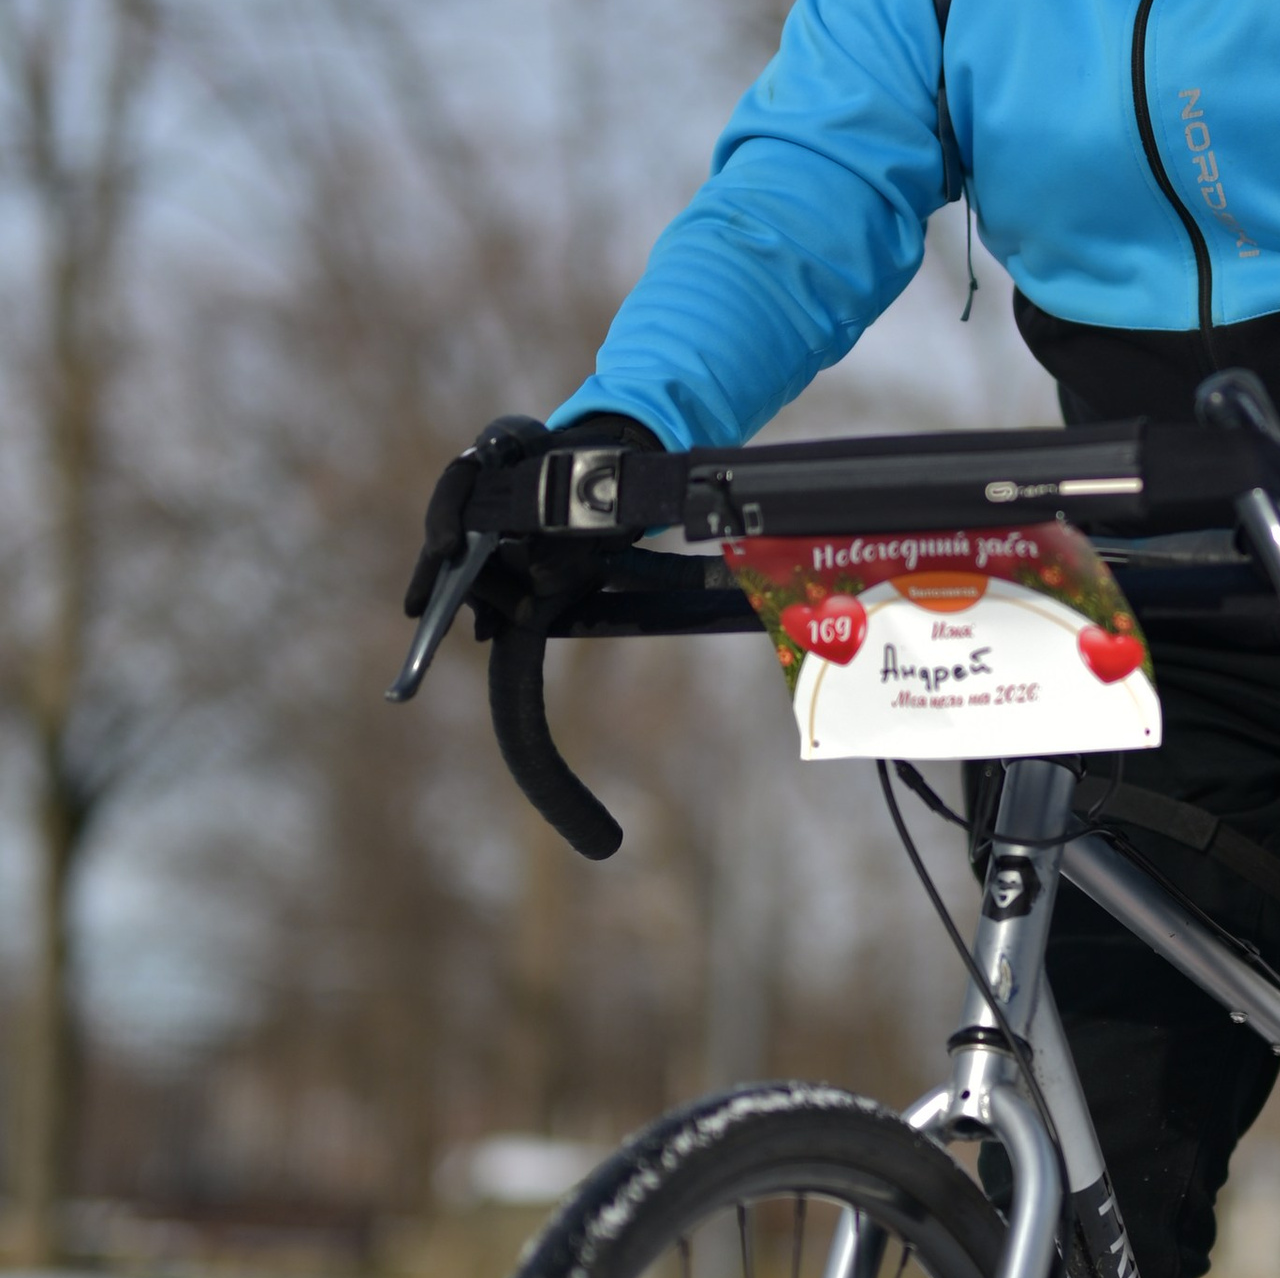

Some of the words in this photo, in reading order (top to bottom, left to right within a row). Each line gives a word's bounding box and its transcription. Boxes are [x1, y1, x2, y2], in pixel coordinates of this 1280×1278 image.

[812, 530, 970, 571] Новогодний
[975, 531, 1039, 569] забег
[807, 616, 852, 644] 169
[880, 642, 993, 693] Андрей
